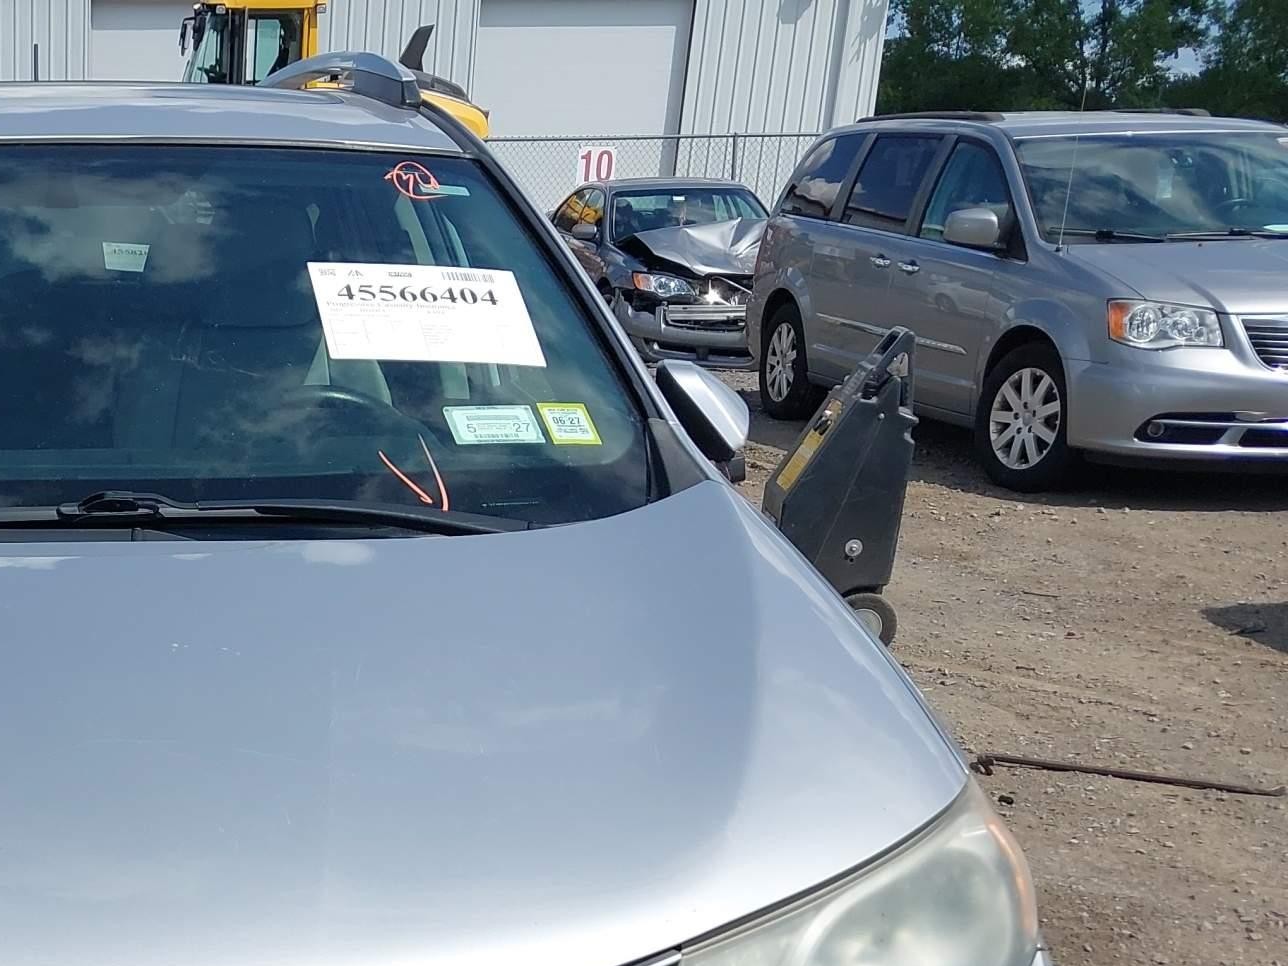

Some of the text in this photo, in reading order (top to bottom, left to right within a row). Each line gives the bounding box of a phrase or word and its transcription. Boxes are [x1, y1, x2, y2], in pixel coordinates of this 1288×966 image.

[581, 150, 613, 182] 10
[337, 283, 499, 306] 45566404
[466, 423, 477, 433] 5
[512, 422, 530, 433] 27
